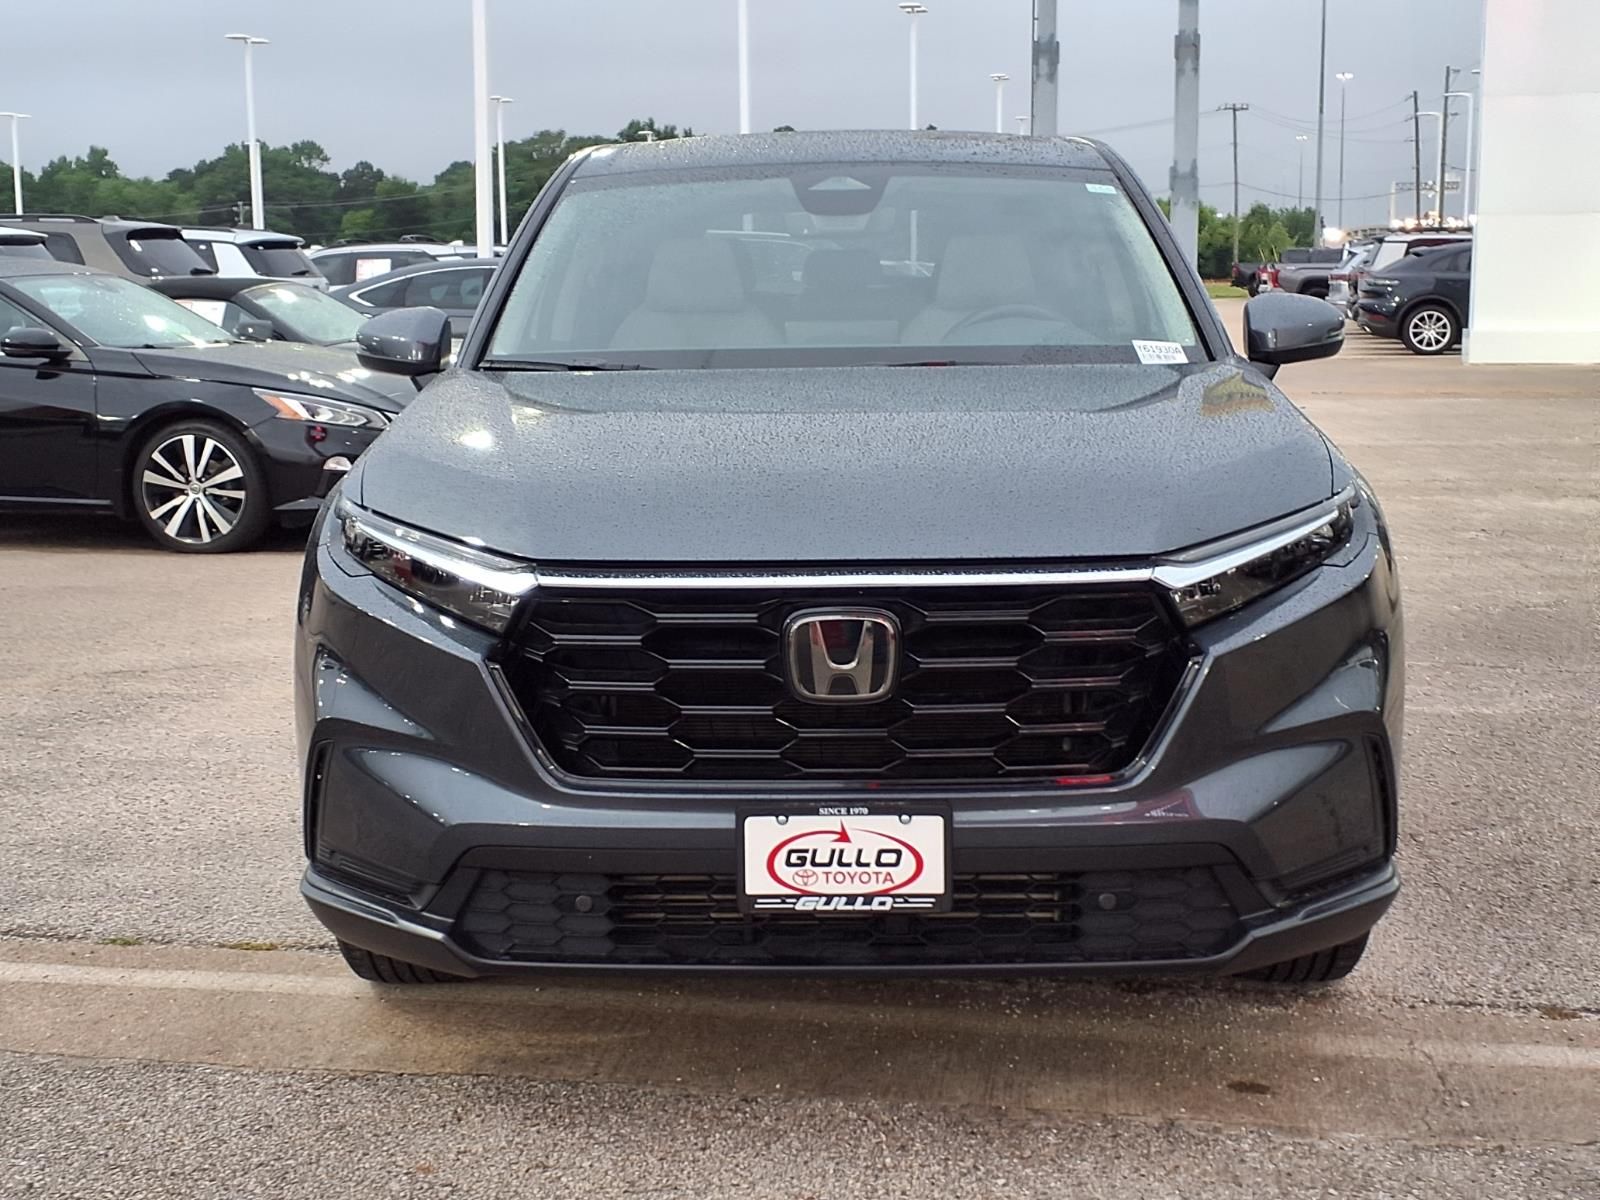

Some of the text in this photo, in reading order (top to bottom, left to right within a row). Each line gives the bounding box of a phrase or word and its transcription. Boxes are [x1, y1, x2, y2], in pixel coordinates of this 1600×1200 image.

[818, 807, 868, 816] SINCE 1970
[784, 848, 903, 868] GULLO
[823, 871, 895, 884] TOYOTA
[794, 896, 893, 911] GULLO
